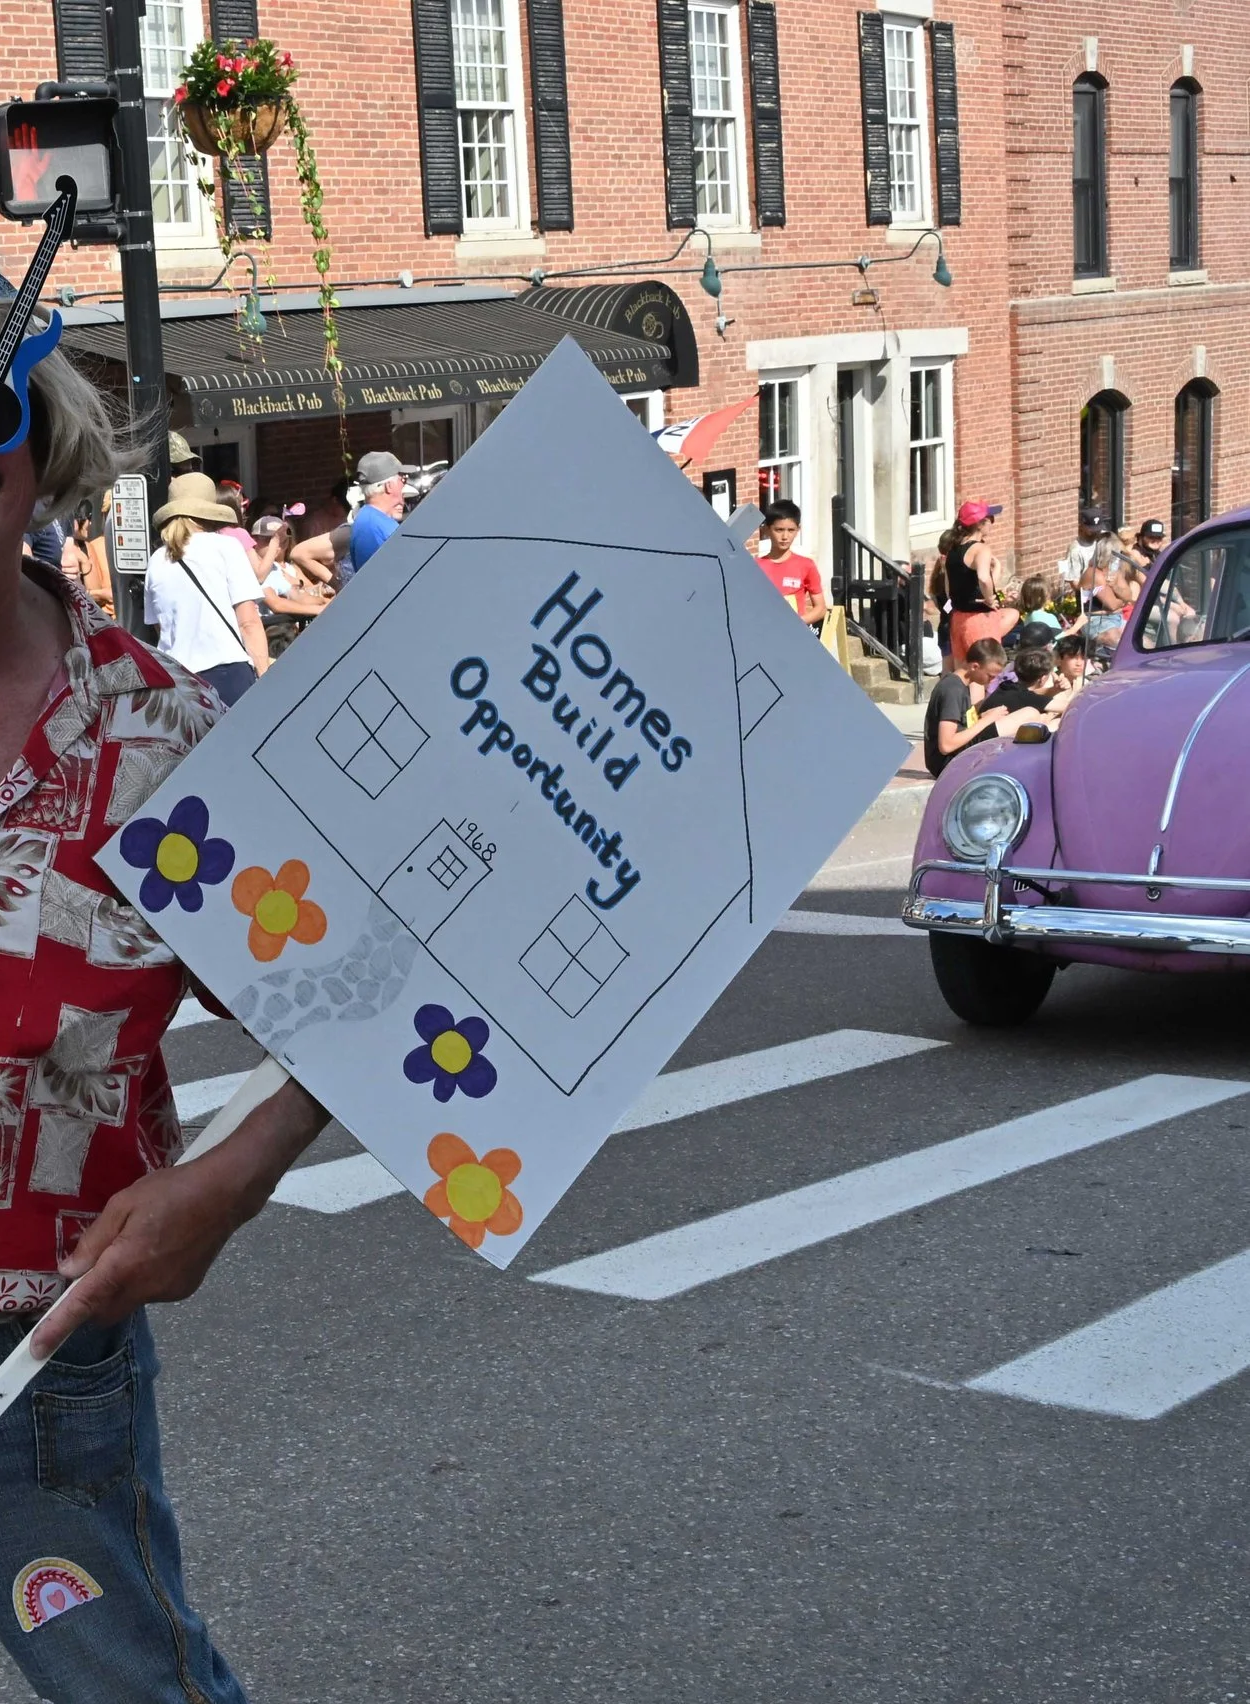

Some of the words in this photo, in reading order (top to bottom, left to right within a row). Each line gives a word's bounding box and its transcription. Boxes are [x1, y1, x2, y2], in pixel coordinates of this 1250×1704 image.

[624, 290, 664, 324] Blackback
[603, 368, 626, 384] back
[626, 367, 647, 383] Pub
[232, 394, 296, 416] Blackback
[297, 392, 323, 410] Pub
[361, 385, 419, 404] Blackback
[418, 382, 443, 400] Pub
[519, 642, 641, 792] Build
[450, 656, 642, 911] Opportunity
[456, 817, 497, 862] 1968
